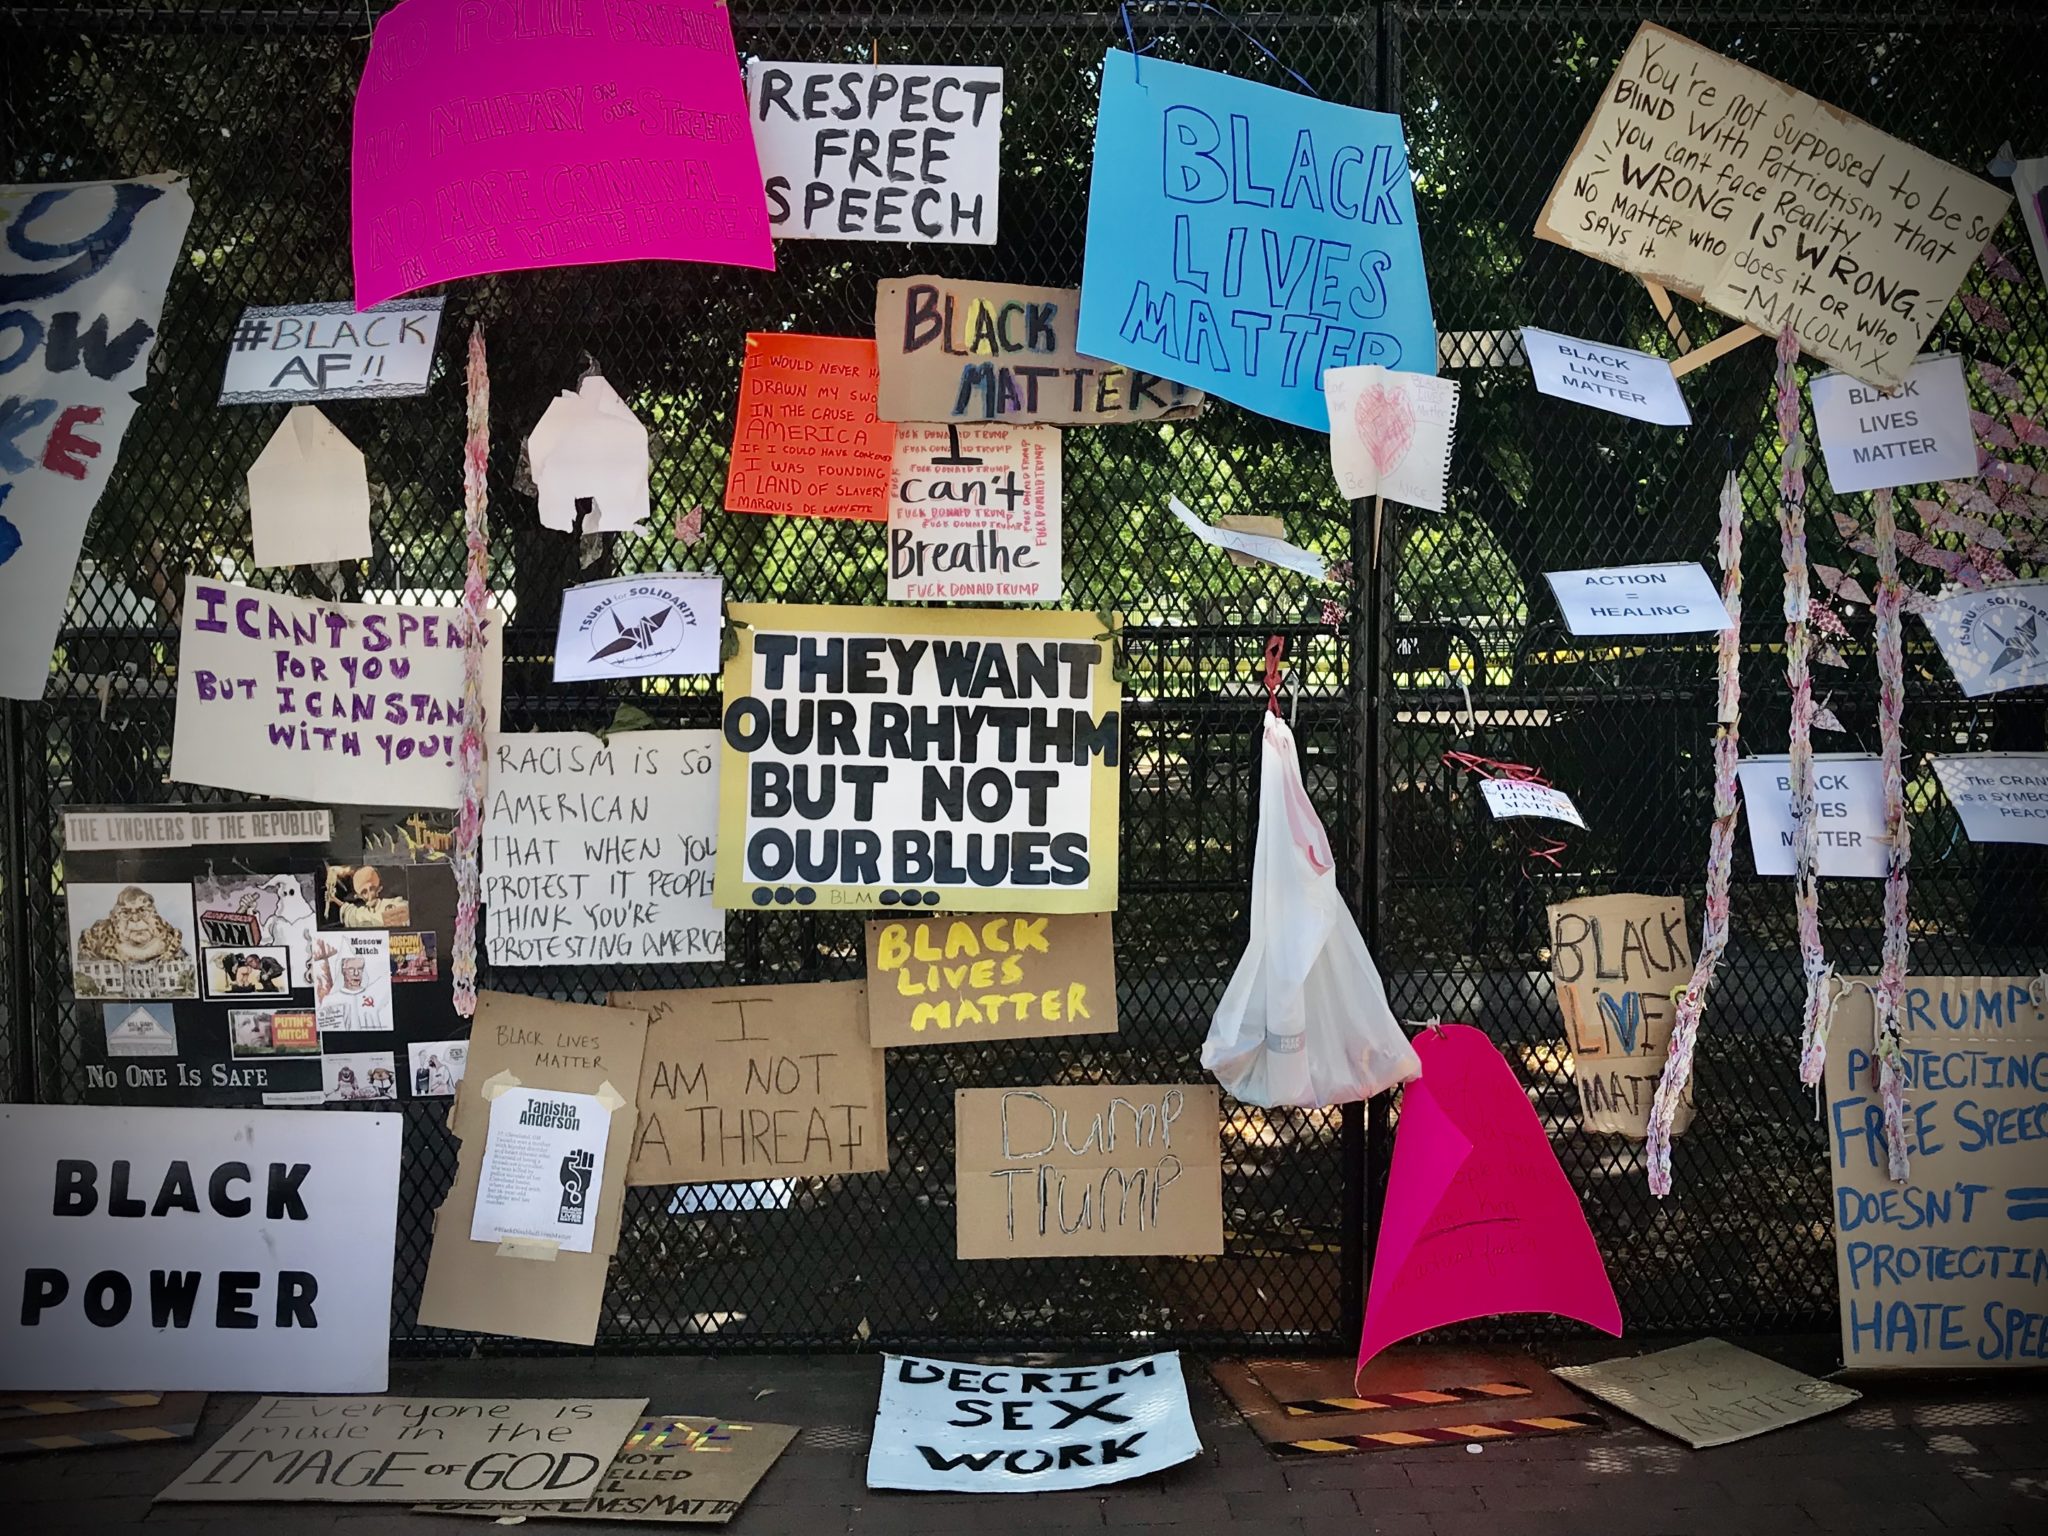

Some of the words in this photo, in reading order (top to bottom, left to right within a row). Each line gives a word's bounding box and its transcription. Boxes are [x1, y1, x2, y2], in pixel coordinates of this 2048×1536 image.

[760, 69, 1000, 127] RESPECT
[814, 128, 955, 184] FREE
[1164, 105, 1407, 225] BLACK
[1622, 154, 1735, 222] WRONG
[765, 176, 983, 238] SPEECH
[1173, 215, 1391, 320] LIVES
[233, 314, 427, 351] #BLACK
[903, 284, 1056, 356] BLACK
[770, 355, 814, 371] WOULD
[819, 363, 860, 377] NEVER
[1559, 345, 1630, 370] BLACK
[1570, 362, 1629, 385] LIVES
[1861, 349, 1888, 374] X
[752, 379, 808, 397] DRAWN
[818, 387, 839, 400] MY
[1562, 375, 1647, 405] MATTER
[751, 403, 773, 418] IN
[780, 405, 806, 417] THE
[812, 407, 856, 422] CAUSE
[1860, 411, 1918, 433] LIVES
[746, 419, 867, 445] AMERICA
[1853, 438, 1938, 463] MATTER
[732, 472, 746, 493] A
[756, 476, 802, 495] LAND
[808, 483, 829, 496] OF
[771, 463, 805, 474] WAS
[818, 465, 885, 479] FOUNDING
[803, 503, 816, 514] DE
[900, 471, 1025, 511] can't
[891, 528, 1040, 579] Breathe
[1585, 574, 1666, 585] ACTION
[195, 586, 227, 634] I
[579, 598, 612, 632] TSURU
[630, 587, 696, 626] SOLIDARITY
[1591, 605, 1690, 617] HEALING
[273, 650, 328, 682] FOR
[340, 657, 410, 688] YOU
[754, 634, 928, 695] THEY
[933, 641, 1102, 699] WANT
[194, 671, 257, 704] BUT
[277, 687, 295, 714] I
[305, 691, 376, 723] CAN
[723, 696, 860, 755] OUR
[869, 702, 1119, 767] RHYTHM
[376, 734, 454, 767] YOU!
[497, 744, 614, 775] RACISM
[751, 762, 888, 821] BUT
[922, 765, 1059, 827] NOT
[1966, 776, 1995, 785] The
[493, 790, 648, 825] AMERICAN
[70, 817, 99, 842] THE
[105, 817, 184, 841] LYNCHERS
[192, 816, 210, 840] OF
[217, 814, 246, 840] THE
[252, 811, 324, 837] REPUBLIC
[488, 835, 559, 866] THAT
[585, 838, 660, 864] WHEN
[747, 827, 881, 885] OUR
[892, 830, 1090, 887] BLUES
[486, 874, 590, 908] PROTEST
[610, 871, 636, 898] IT
[830, 889, 873, 905] BLM
[490, 905, 572, 938] THINK
[584, 901, 662, 929] YOU'RE
[355, 947, 379, 955] Mitch
[490, 933, 632, 964] PROTESTING
[877, 918, 1049, 971] BLACK
[1554, 912, 1687, 984] BLACK
[897, 954, 1023, 996] LIVES
[275, 1016, 313, 1028] PUTIN'S
[712, 998, 773, 1042] I
[911, 982, 1090, 1032] MATTER
[277, 1028, 309, 1039] MITCH
[496, 1025, 543, 1046] BLACK
[557, 1033, 600, 1049] LIVES
[535, 1052, 608, 1071] MATTER
[651, 1061, 709, 1102] AM
[745, 1053, 838, 1095] NOT
[519, 1110, 580, 1131] Anderson
[528, 1098, 577, 1118] Tanisha
[636, 1112, 671, 1165] A
[53, 1160, 311, 1221] BLACK
[1838, 1183, 1987, 1230] DOESN'T
[20, 1268, 318, 1329] POWER
[1851, 1299, 1970, 1353] HATE
[899, 1360, 1155, 1393] DECRIM
[262, 1400, 510, 1427] Everyone
[948, 1393, 1133, 1430] SEX
[240, 1422, 369, 1442] made
[488, 1423, 572, 1443] the
[185, 1450, 429, 1487] IMAGE
[465, 1453, 599, 1490] GOD
[916, 1432, 1148, 1474] WORK
